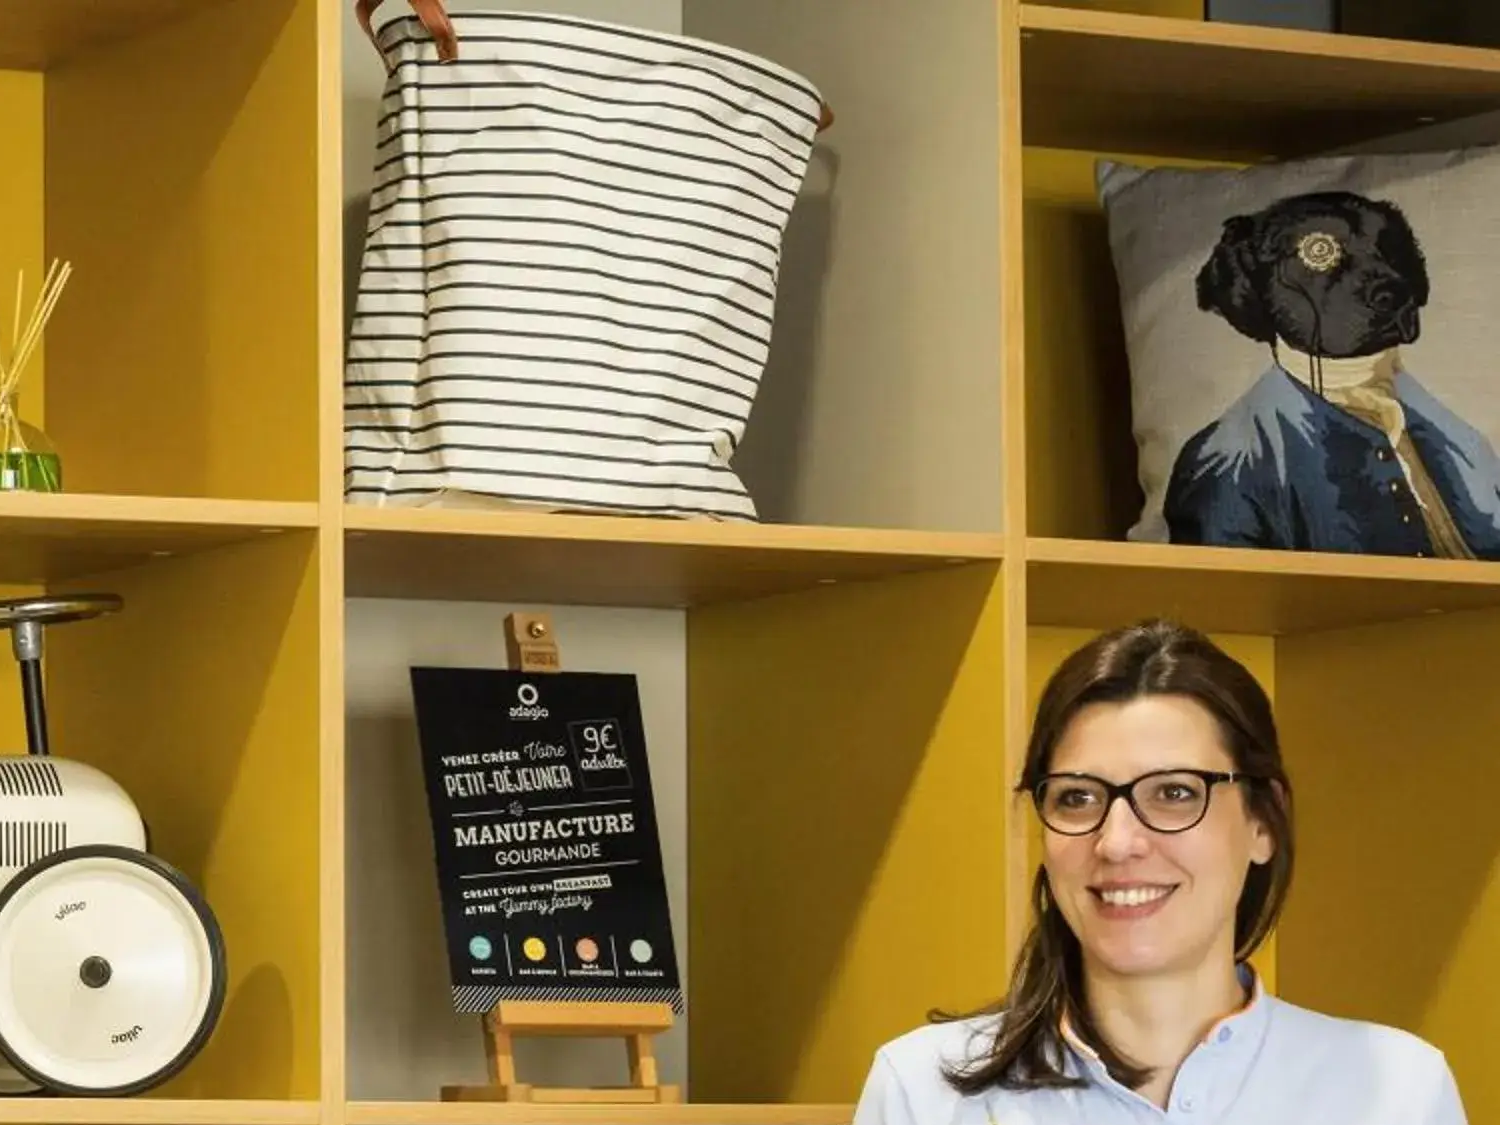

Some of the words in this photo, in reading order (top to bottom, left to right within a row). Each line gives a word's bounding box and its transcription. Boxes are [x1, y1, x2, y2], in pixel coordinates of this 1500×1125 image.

[509, 705, 549, 721] adagio
[583, 724, 617, 753] 9€
[442, 754, 480, 767] VENEZ
[481, 749, 521, 764] CRÉER
[444, 765, 573, 798] PETIT-DÉJEUNER
[454, 813, 635, 847] MANUFACTURE
[495, 842, 602, 866] GOURMANDE
[463, 887, 499, 899] CREATE
[500, 885, 527, 896] YOUR
[529, 884, 553, 894] OWN
[465, 905, 477, 915] AT
[478, 904, 496, 914] THE
